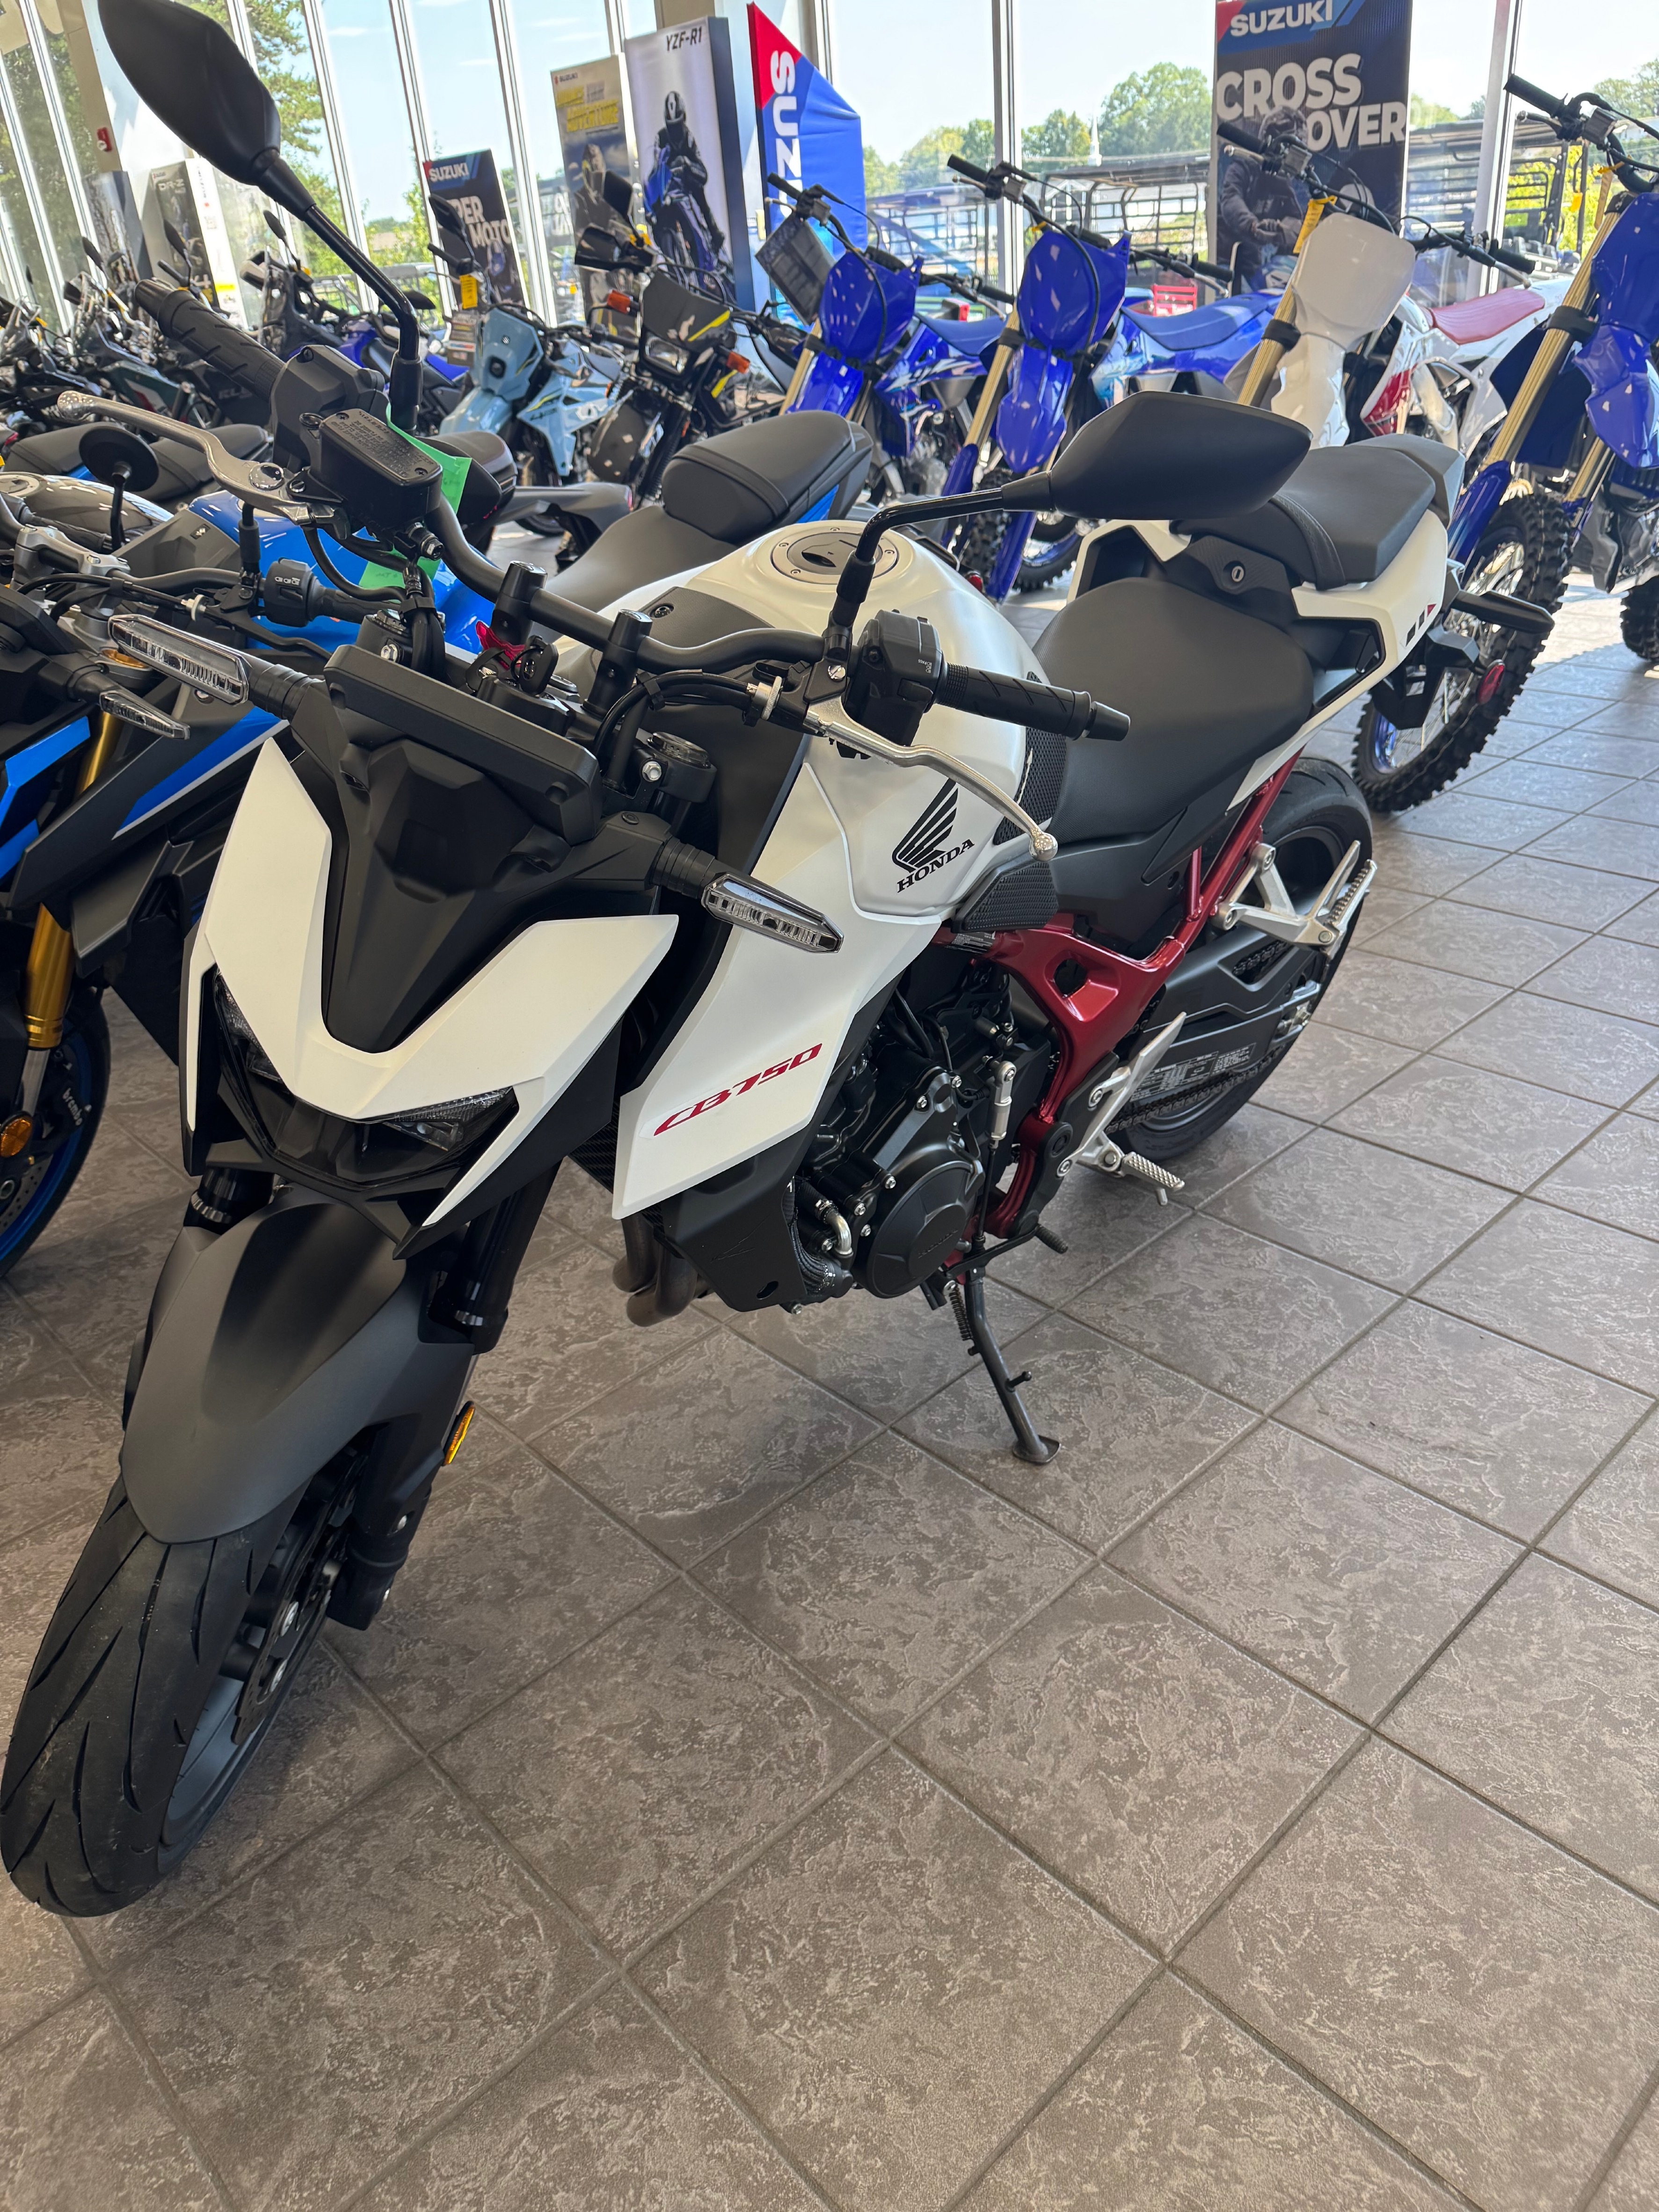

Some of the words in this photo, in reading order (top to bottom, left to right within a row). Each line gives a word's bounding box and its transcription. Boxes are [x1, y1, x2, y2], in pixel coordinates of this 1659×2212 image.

[1230, 0, 1333, 37] SUZUKI
[666, 27, 702, 51] YZF-R1
[1216, 53, 1361, 121] CROSS
[770, 50, 803, 218] SUZU
[1307, 101, 1407, 152] OVER
[429, 162, 470, 182] SUZUKI
[442, 196, 486, 225] PER
[468, 219, 511, 248] MOTO
[897, 839, 975, 893] HONDA
[62, 1087, 83, 1126] brembo
[654, 1043, 822, 1136] CB750
